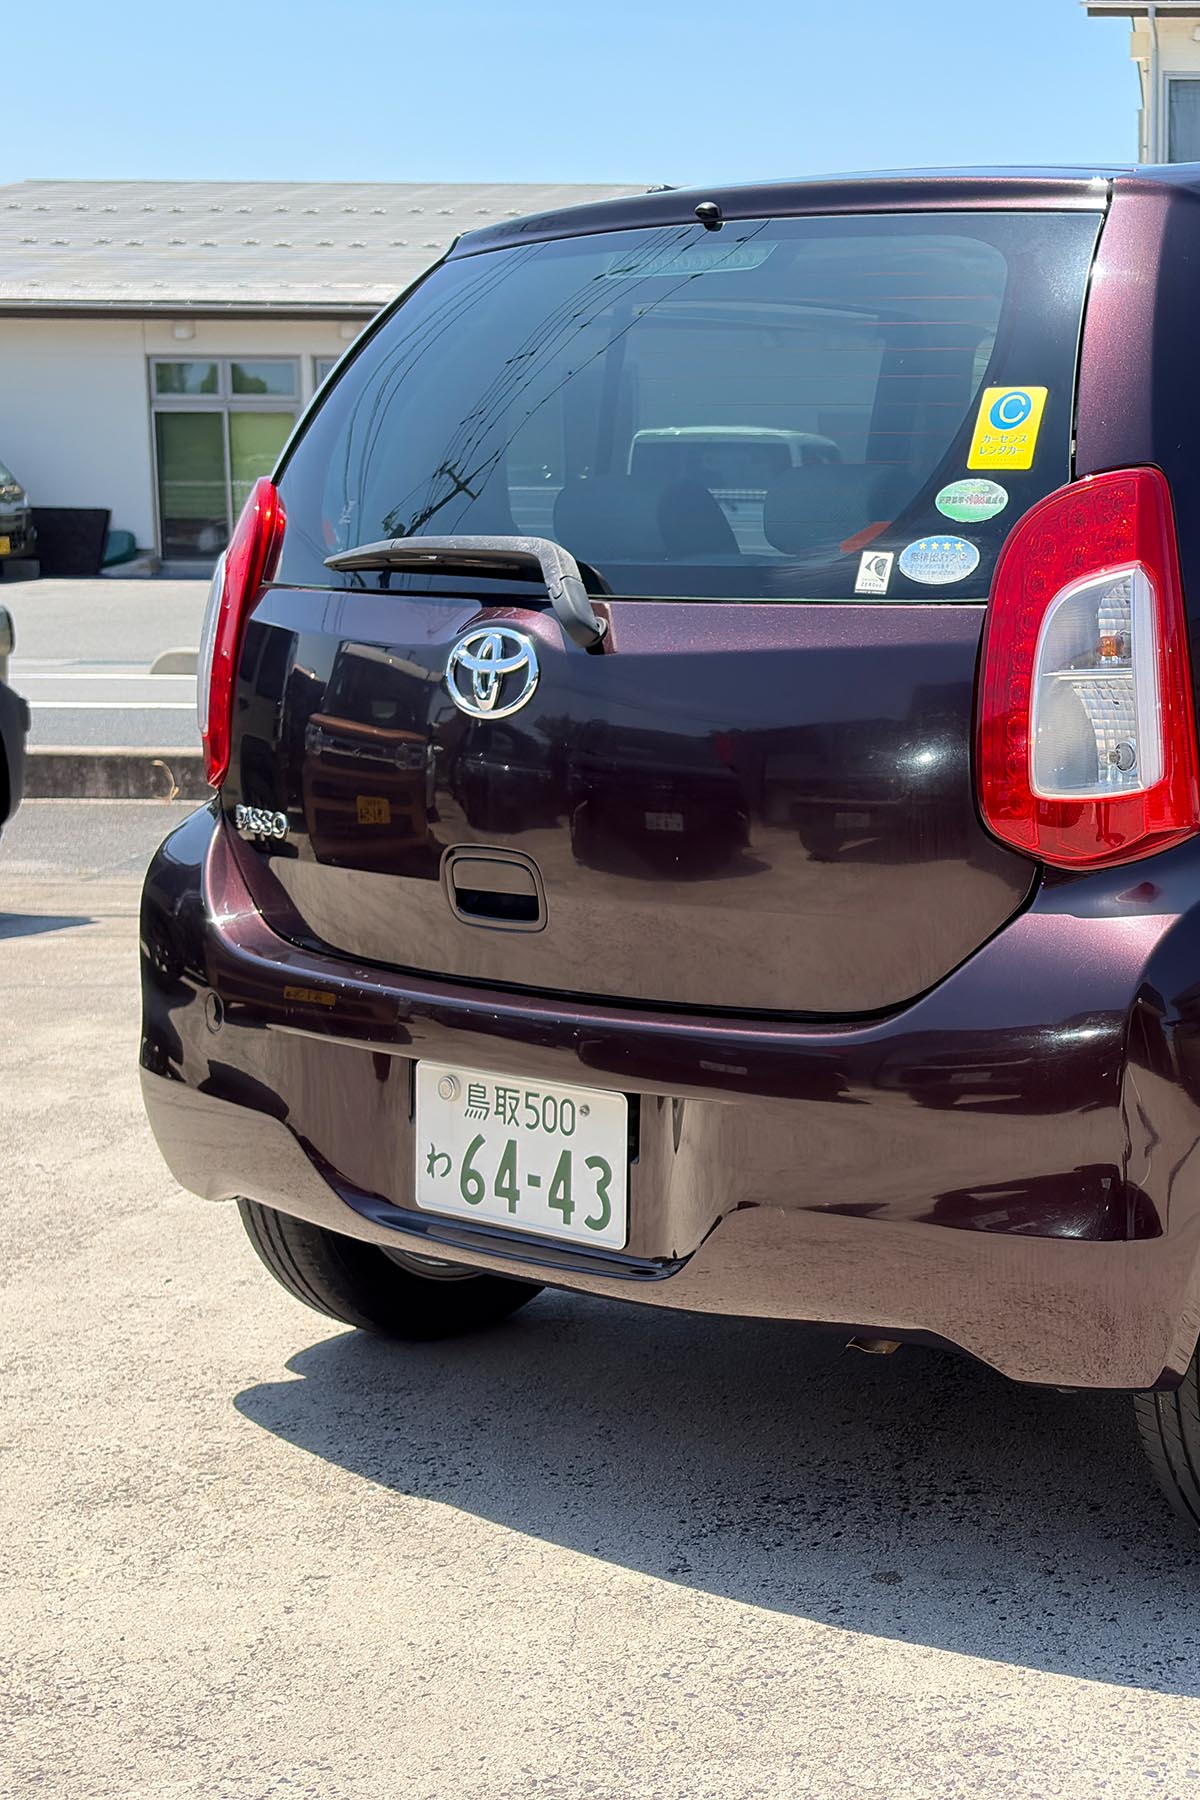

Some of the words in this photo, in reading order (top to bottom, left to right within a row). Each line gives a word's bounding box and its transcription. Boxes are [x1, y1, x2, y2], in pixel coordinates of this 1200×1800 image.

[980, 445, 1025, 456] レンタカー
[236, 804, 288, 839] PASSO
[464, 1083, 576, 1137] 鳥取500
[426, 1142, 452, 1179] わ
[460, 1133, 612, 1231] 64-43
